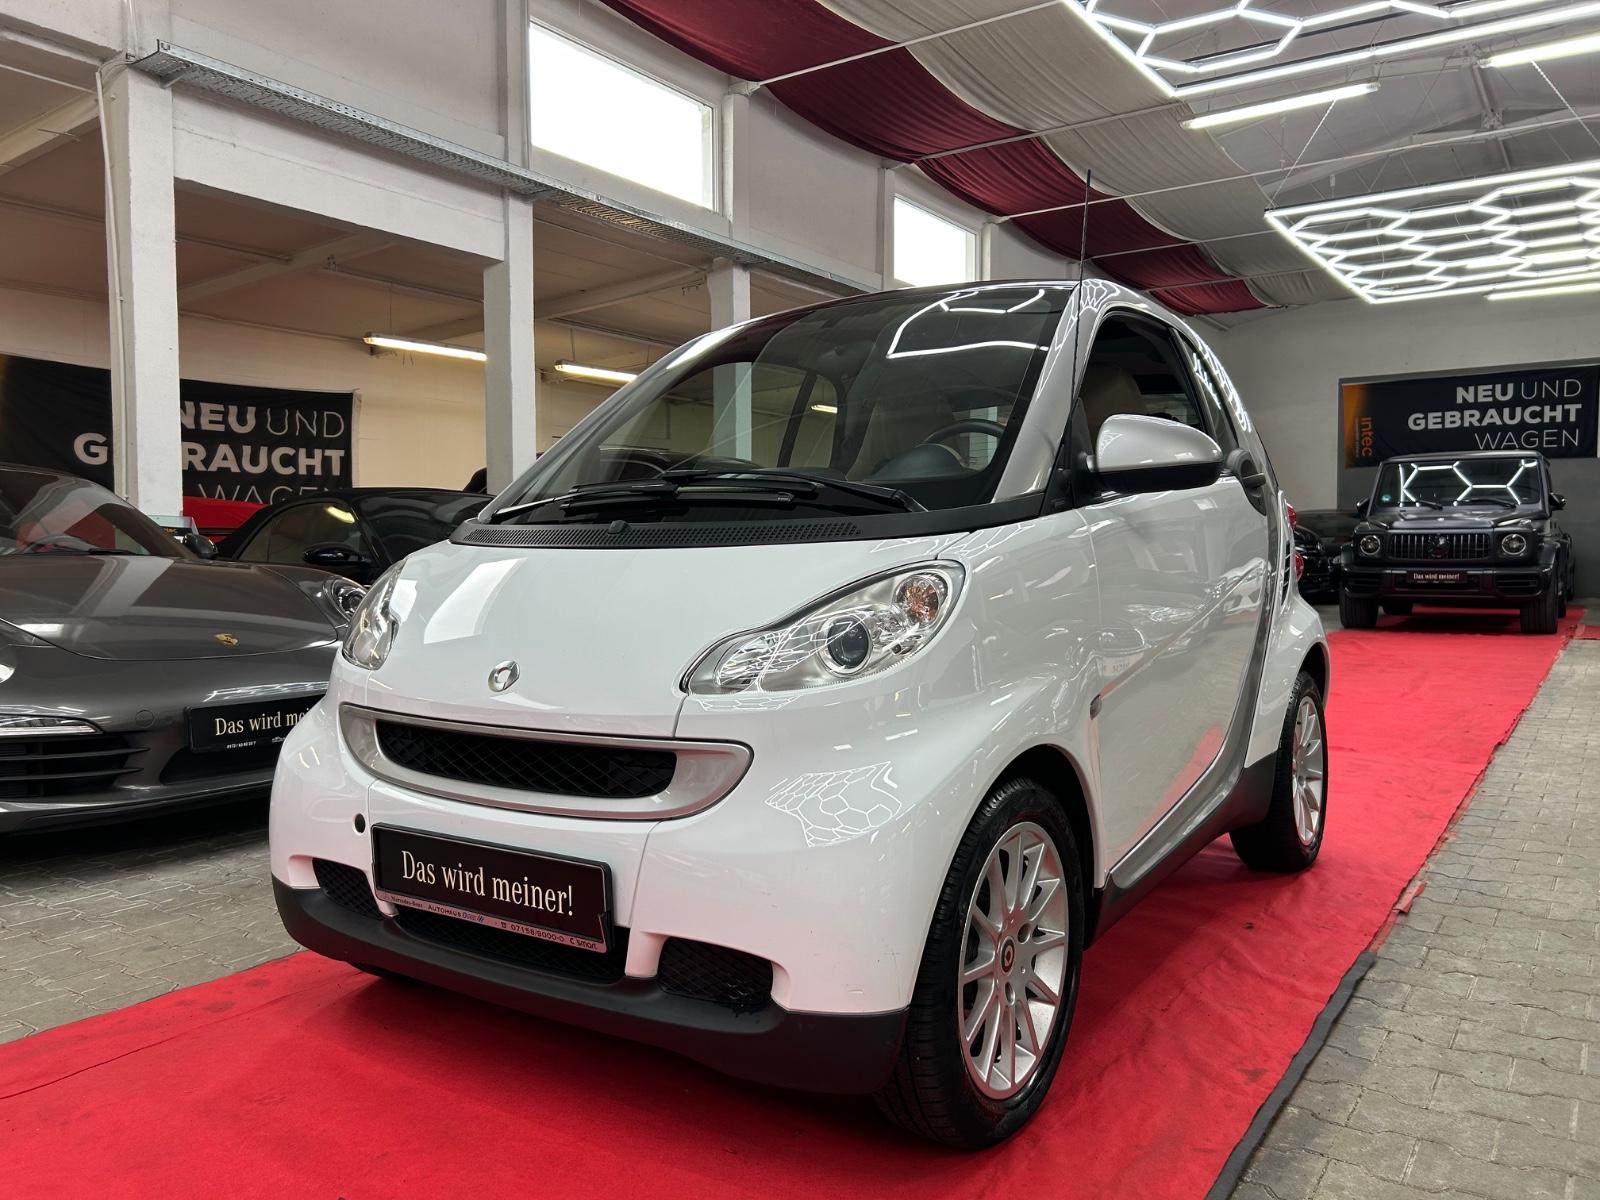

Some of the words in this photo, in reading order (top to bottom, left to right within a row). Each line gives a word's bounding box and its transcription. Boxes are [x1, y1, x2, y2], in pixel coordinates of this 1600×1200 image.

[1456, 383, 1514, 404] NEU
[1521, 379, 1582, 400] UND
[267, 408, 344, 438] UND
[1407, 403, 1582, 431] GEBRAUCHT
[1361, 417, 1373, 456] intec
[1474, 428, 1579, 450] WAGEN
[73, 432, 344, 476] GRAUCHT
[214, 717, 243, 736] Das
[249, 711, 281, 731] wird
[401, 850, 436, 884] Das
[441, 862, 486, 897] wird
[492, 876, 574, 916] meiner!
